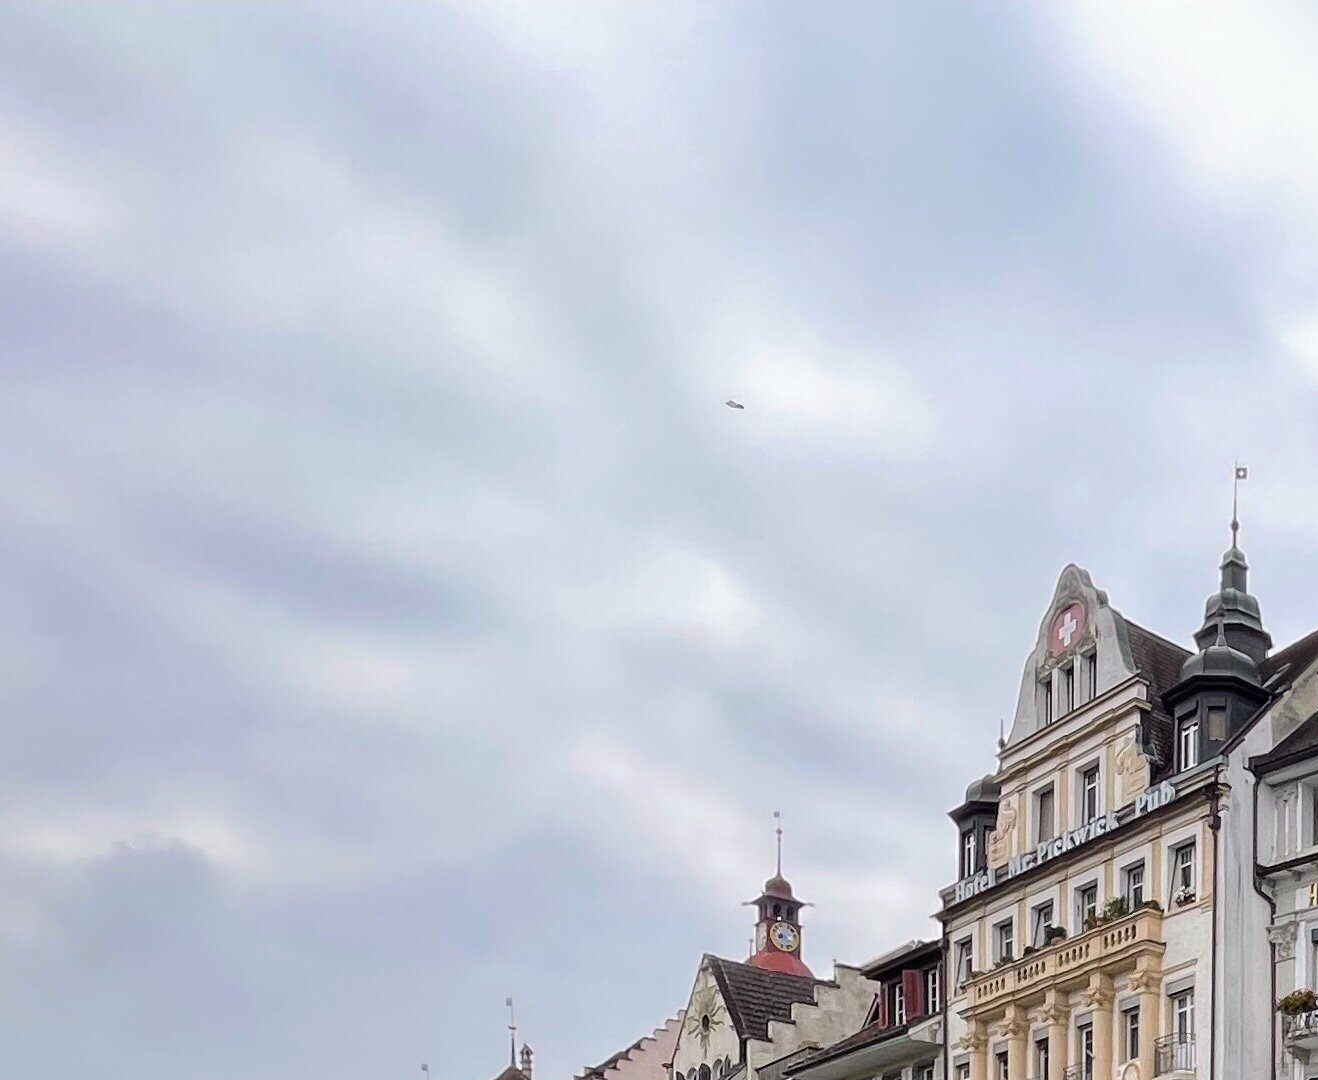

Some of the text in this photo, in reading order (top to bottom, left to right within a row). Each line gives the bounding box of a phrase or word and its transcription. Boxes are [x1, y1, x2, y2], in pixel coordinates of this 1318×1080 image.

[955, 868, 997, 902] Hotel
[1037, 810, 1120, 863] Pickwick
[1134, 781, 1177, 818] Pub
